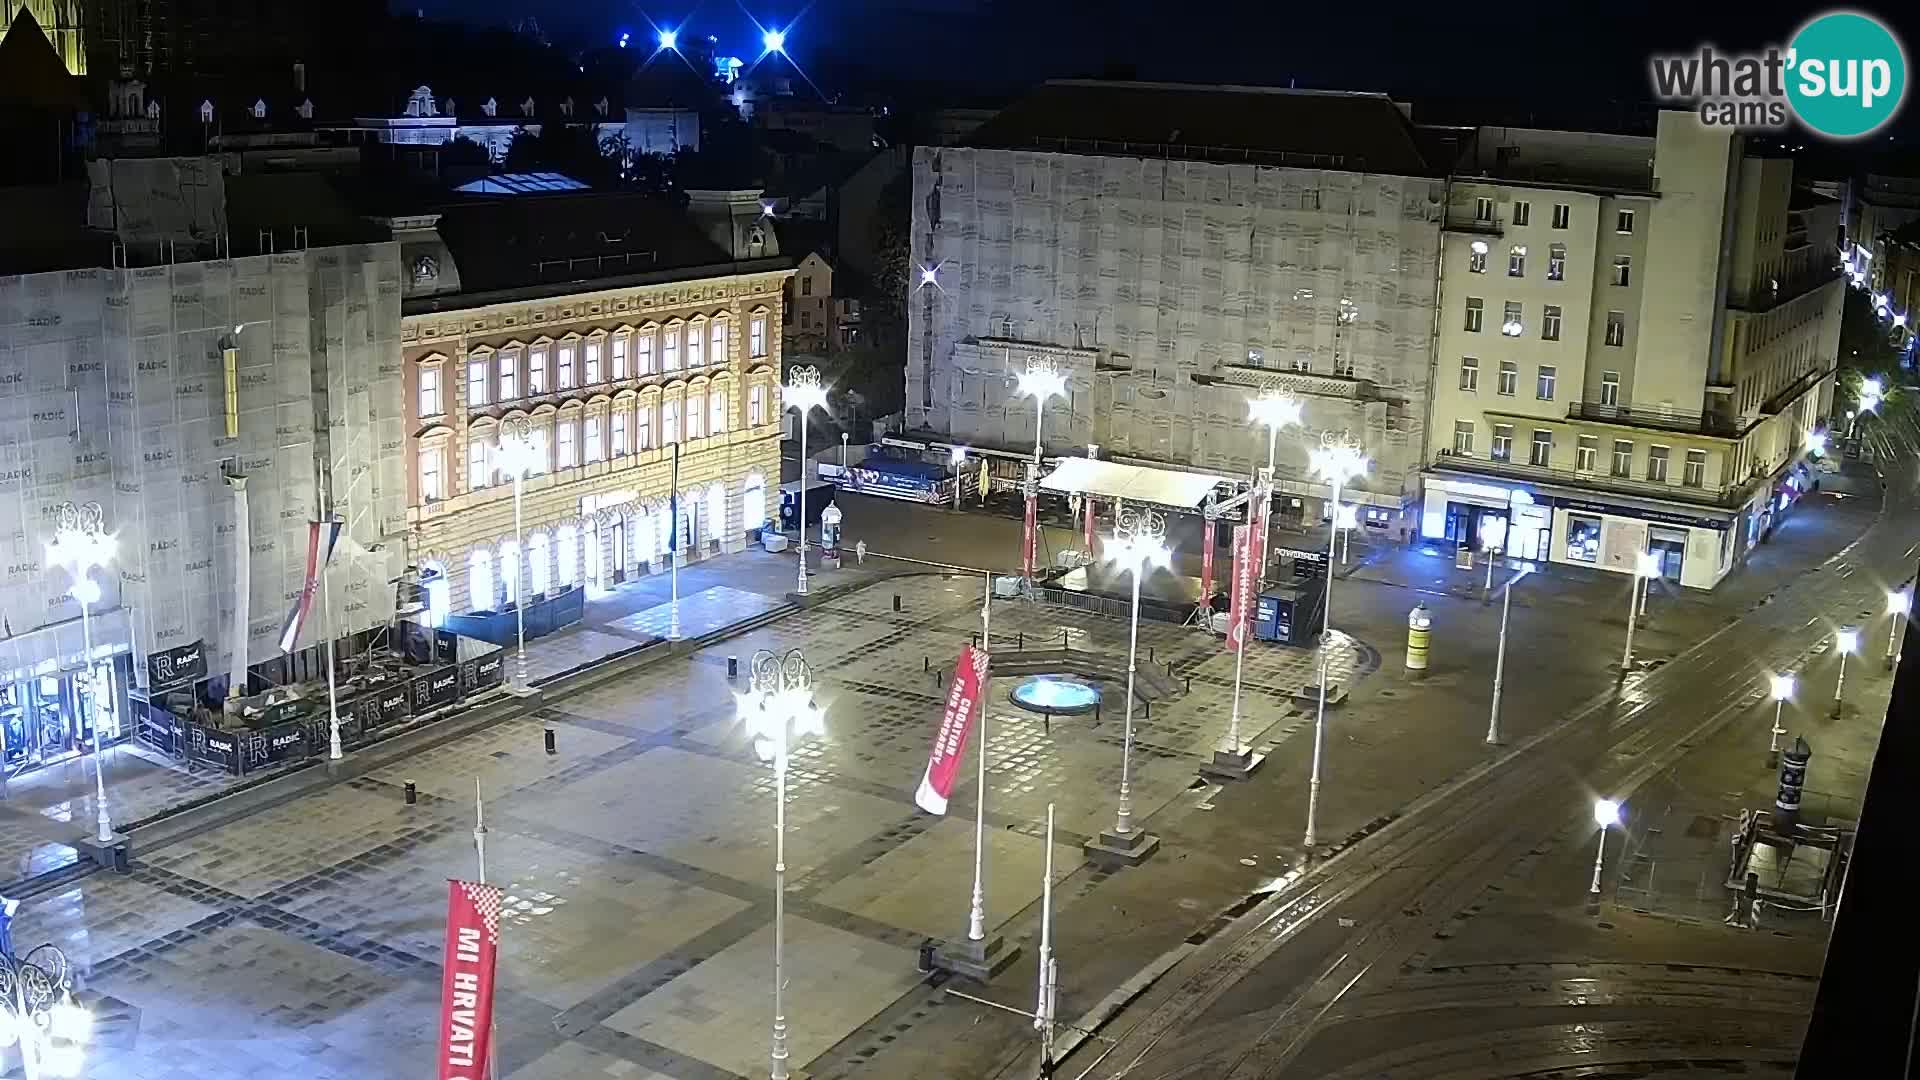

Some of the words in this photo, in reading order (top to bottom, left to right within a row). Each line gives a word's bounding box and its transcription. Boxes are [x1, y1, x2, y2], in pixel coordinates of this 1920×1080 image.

[949, 677, 965, 709] FANS
[946, 697, 972, 757] CROATIAN
[457, 927, 480, 962] MI
[448, 972, 478, 1067] HRVATI
